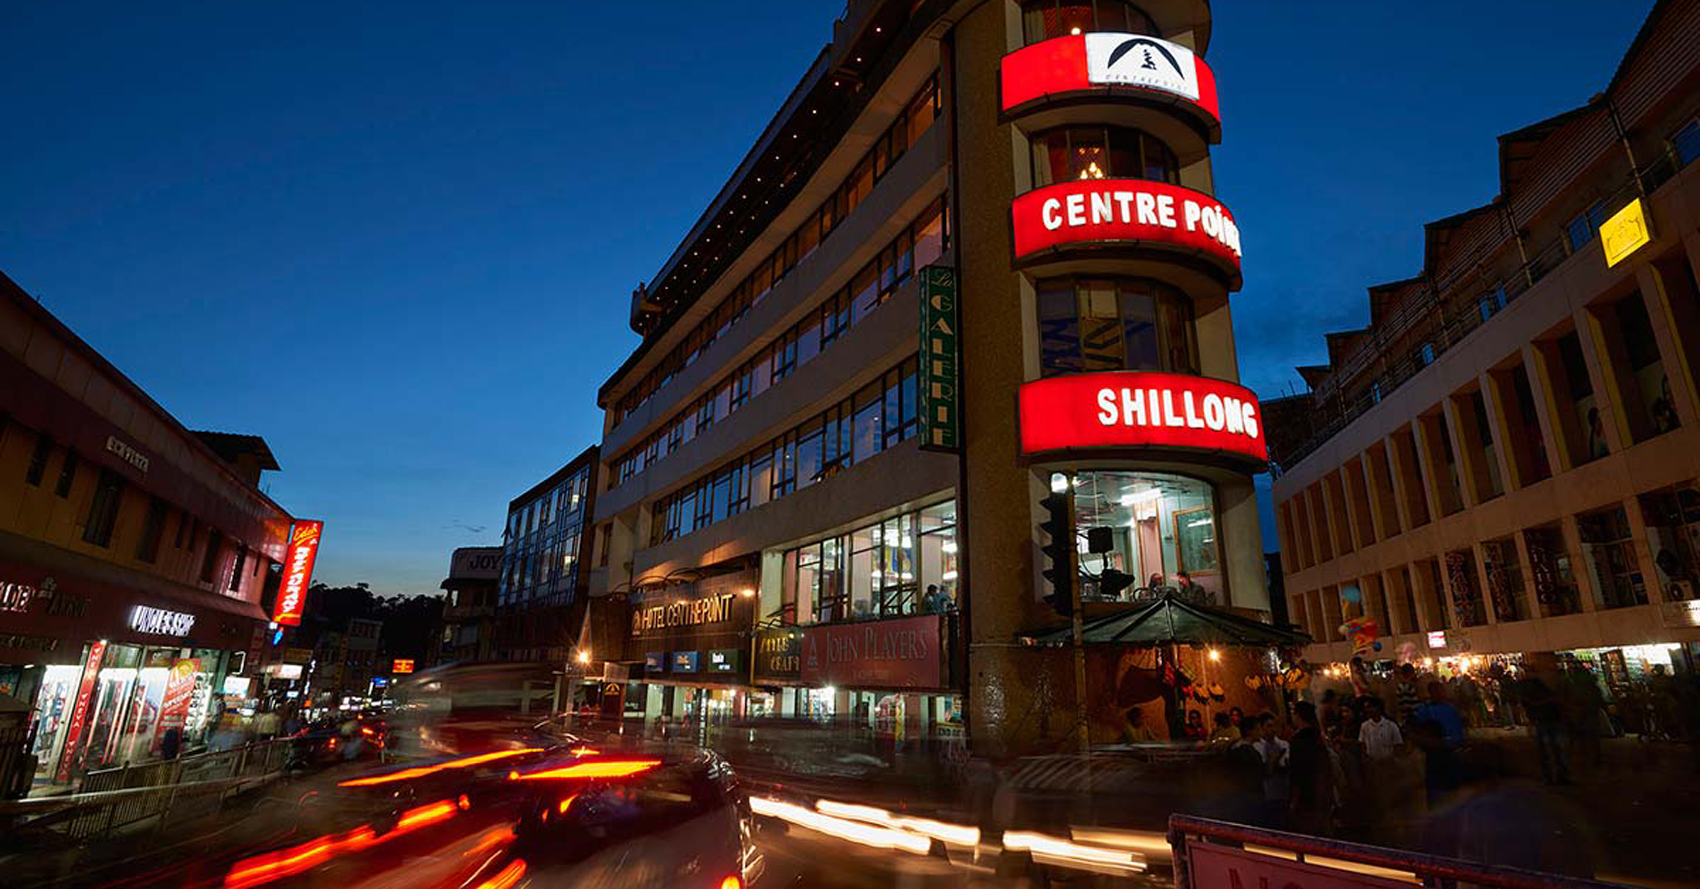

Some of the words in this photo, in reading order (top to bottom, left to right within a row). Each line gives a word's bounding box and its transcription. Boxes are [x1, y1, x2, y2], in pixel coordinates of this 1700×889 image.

[1042, 191, 1176, 231] CENTRE
[930, 294, 954, 446] GALERIE
[1097, 388, 1258, 438] SHILLONG
[642, 605, 666, 630] HOTEL
[826, 632, 858, 666] JOHN
[864, 626, 928, 662] PLAYERS
